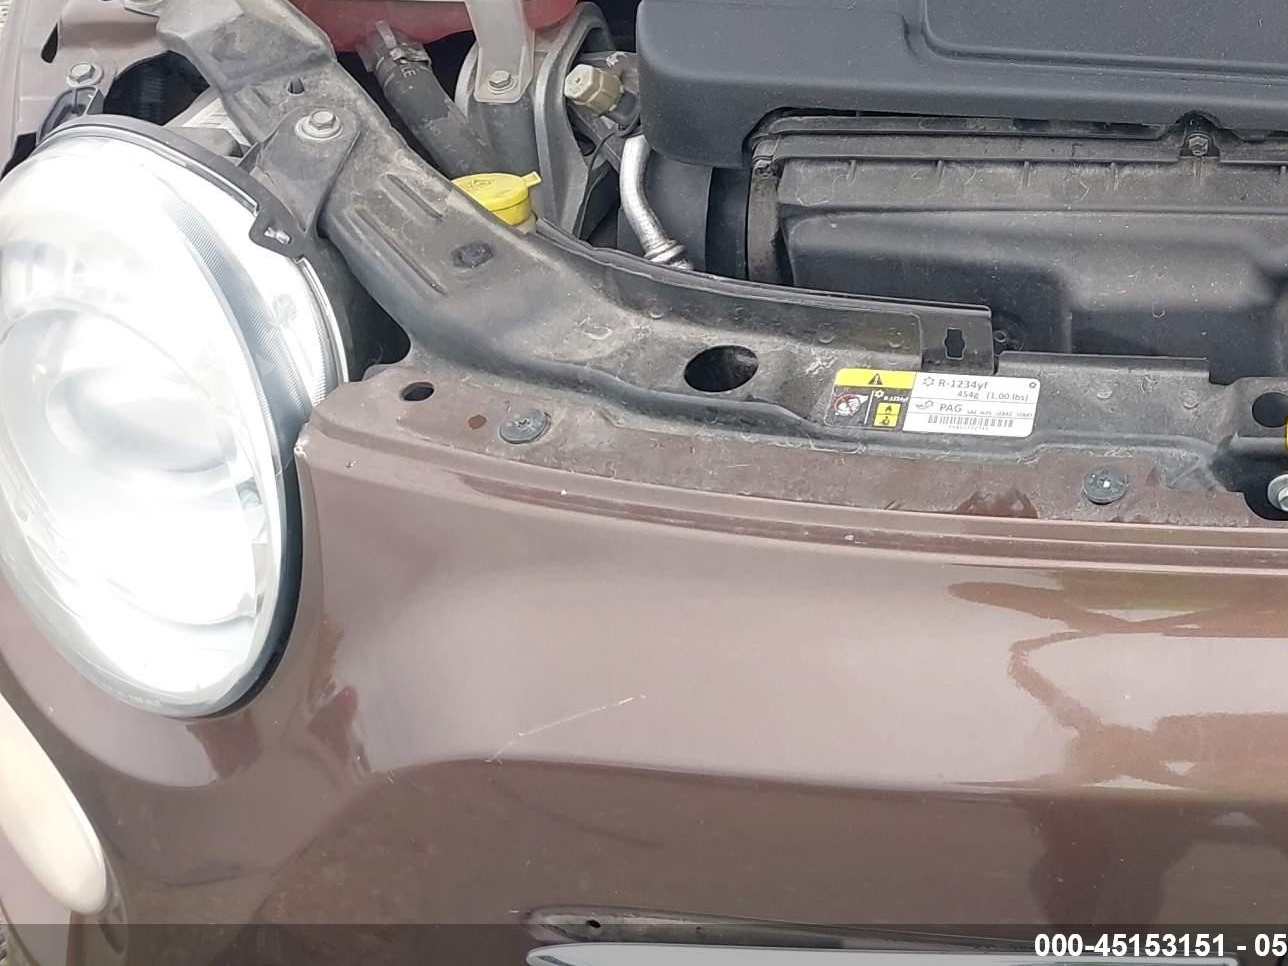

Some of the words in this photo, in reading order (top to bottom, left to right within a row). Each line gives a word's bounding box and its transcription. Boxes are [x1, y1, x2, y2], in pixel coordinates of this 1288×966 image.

[938, 379, 988, 391] R-1234yf
[957, 391, 979, 400] 454g
[986, 392, 1010, 401] (1.00
[1012, 393, 1029, 402] lbs)
[939, 403, 963, 413] PAG
